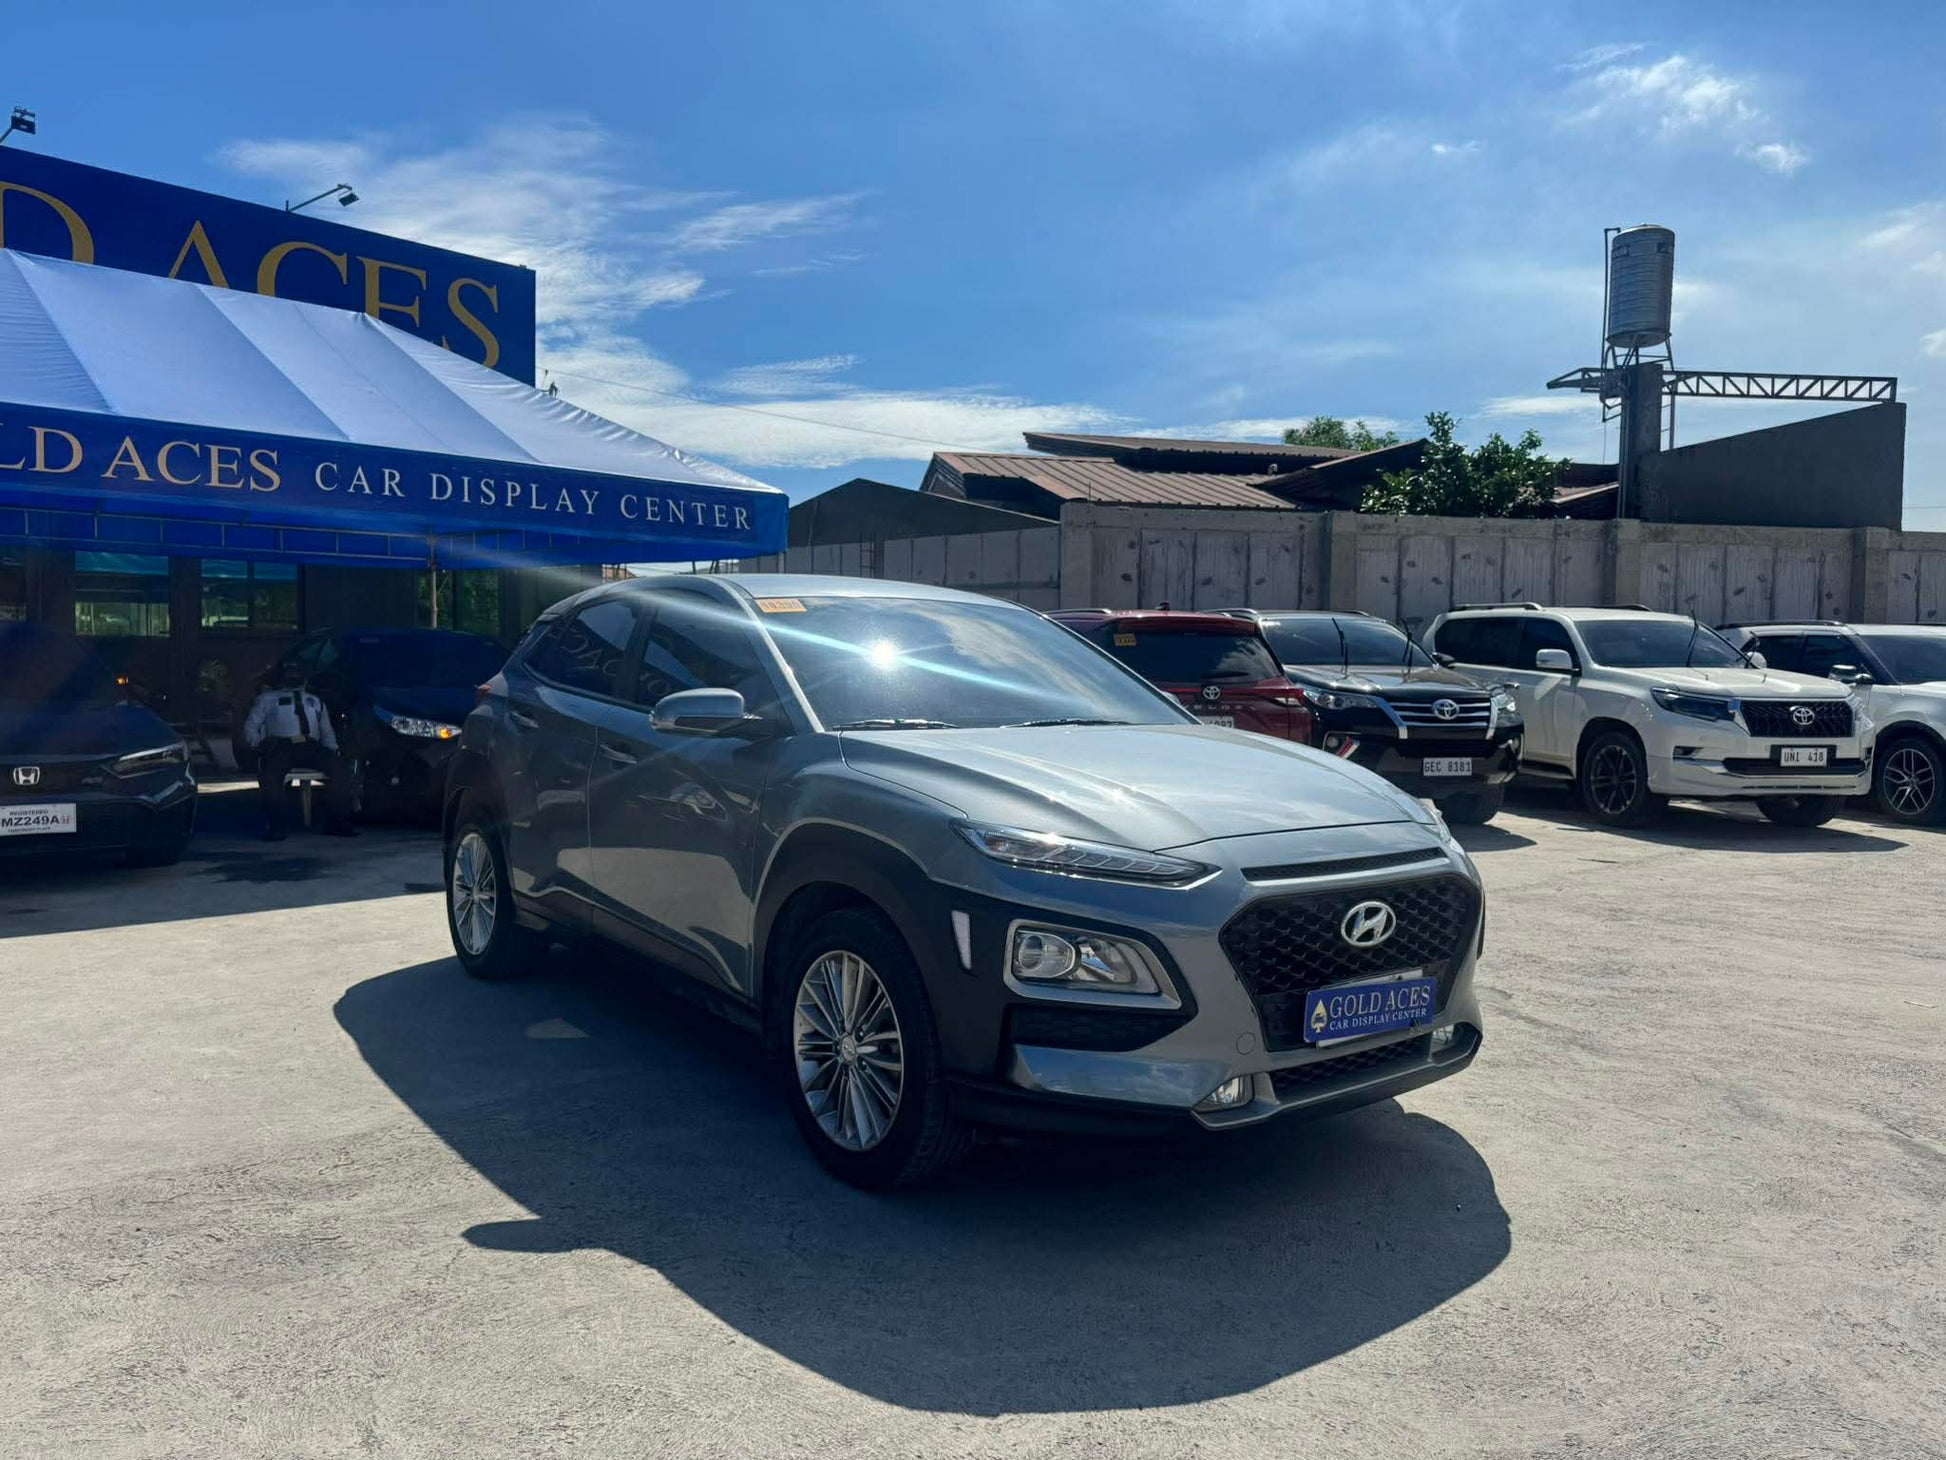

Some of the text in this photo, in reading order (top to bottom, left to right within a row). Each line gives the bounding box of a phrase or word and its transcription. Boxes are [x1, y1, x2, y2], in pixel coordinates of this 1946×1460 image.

[101, 435, 281, 492] ACES
[314, 462, 405, 498] CAR
[430, 472, 600, 515] DISPLAY
[620, 495, 752, 531] CENTER
[1424, 761, 1470, 772] GEC 8181
[1784, 751, 1800, 762] UNI
[1329, 985, 1430, 1018] GOLD ACES
[1329, 1008, 1427, 1031] CAR DISPLAY CENTER
